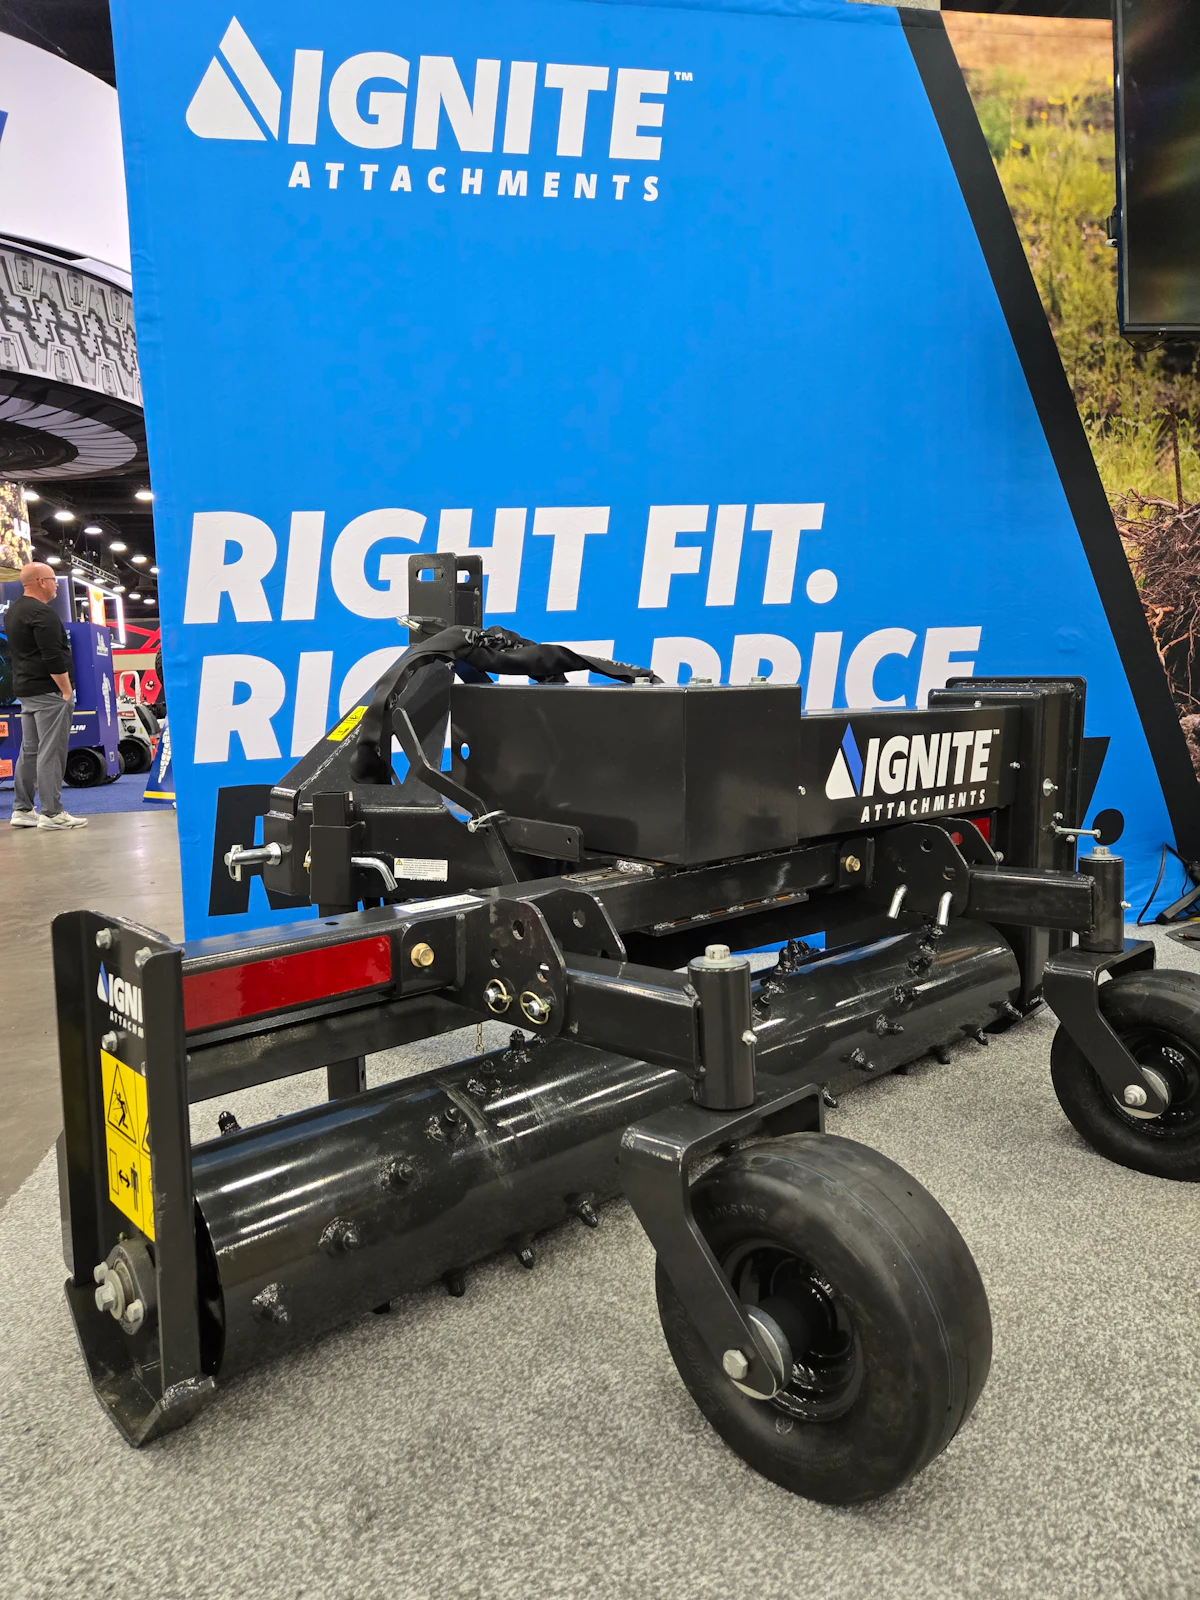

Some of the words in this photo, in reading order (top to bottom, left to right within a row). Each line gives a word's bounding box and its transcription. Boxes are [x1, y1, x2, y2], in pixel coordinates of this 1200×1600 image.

[288, 48, 670, 161] IGNITE
[288, 161, 660, 202] ATTACHMENTS
[183, 504, 611, 624] RIGHT
[637, 502, 839, 608] FIT.
[862, 729, 993, 798] IGNITE
[860, 788, 986, 824] ATTACHMENTS
[108, 972, 143, 1024] IGNI
[109, 1010, 145, 1039] ATTACHM
